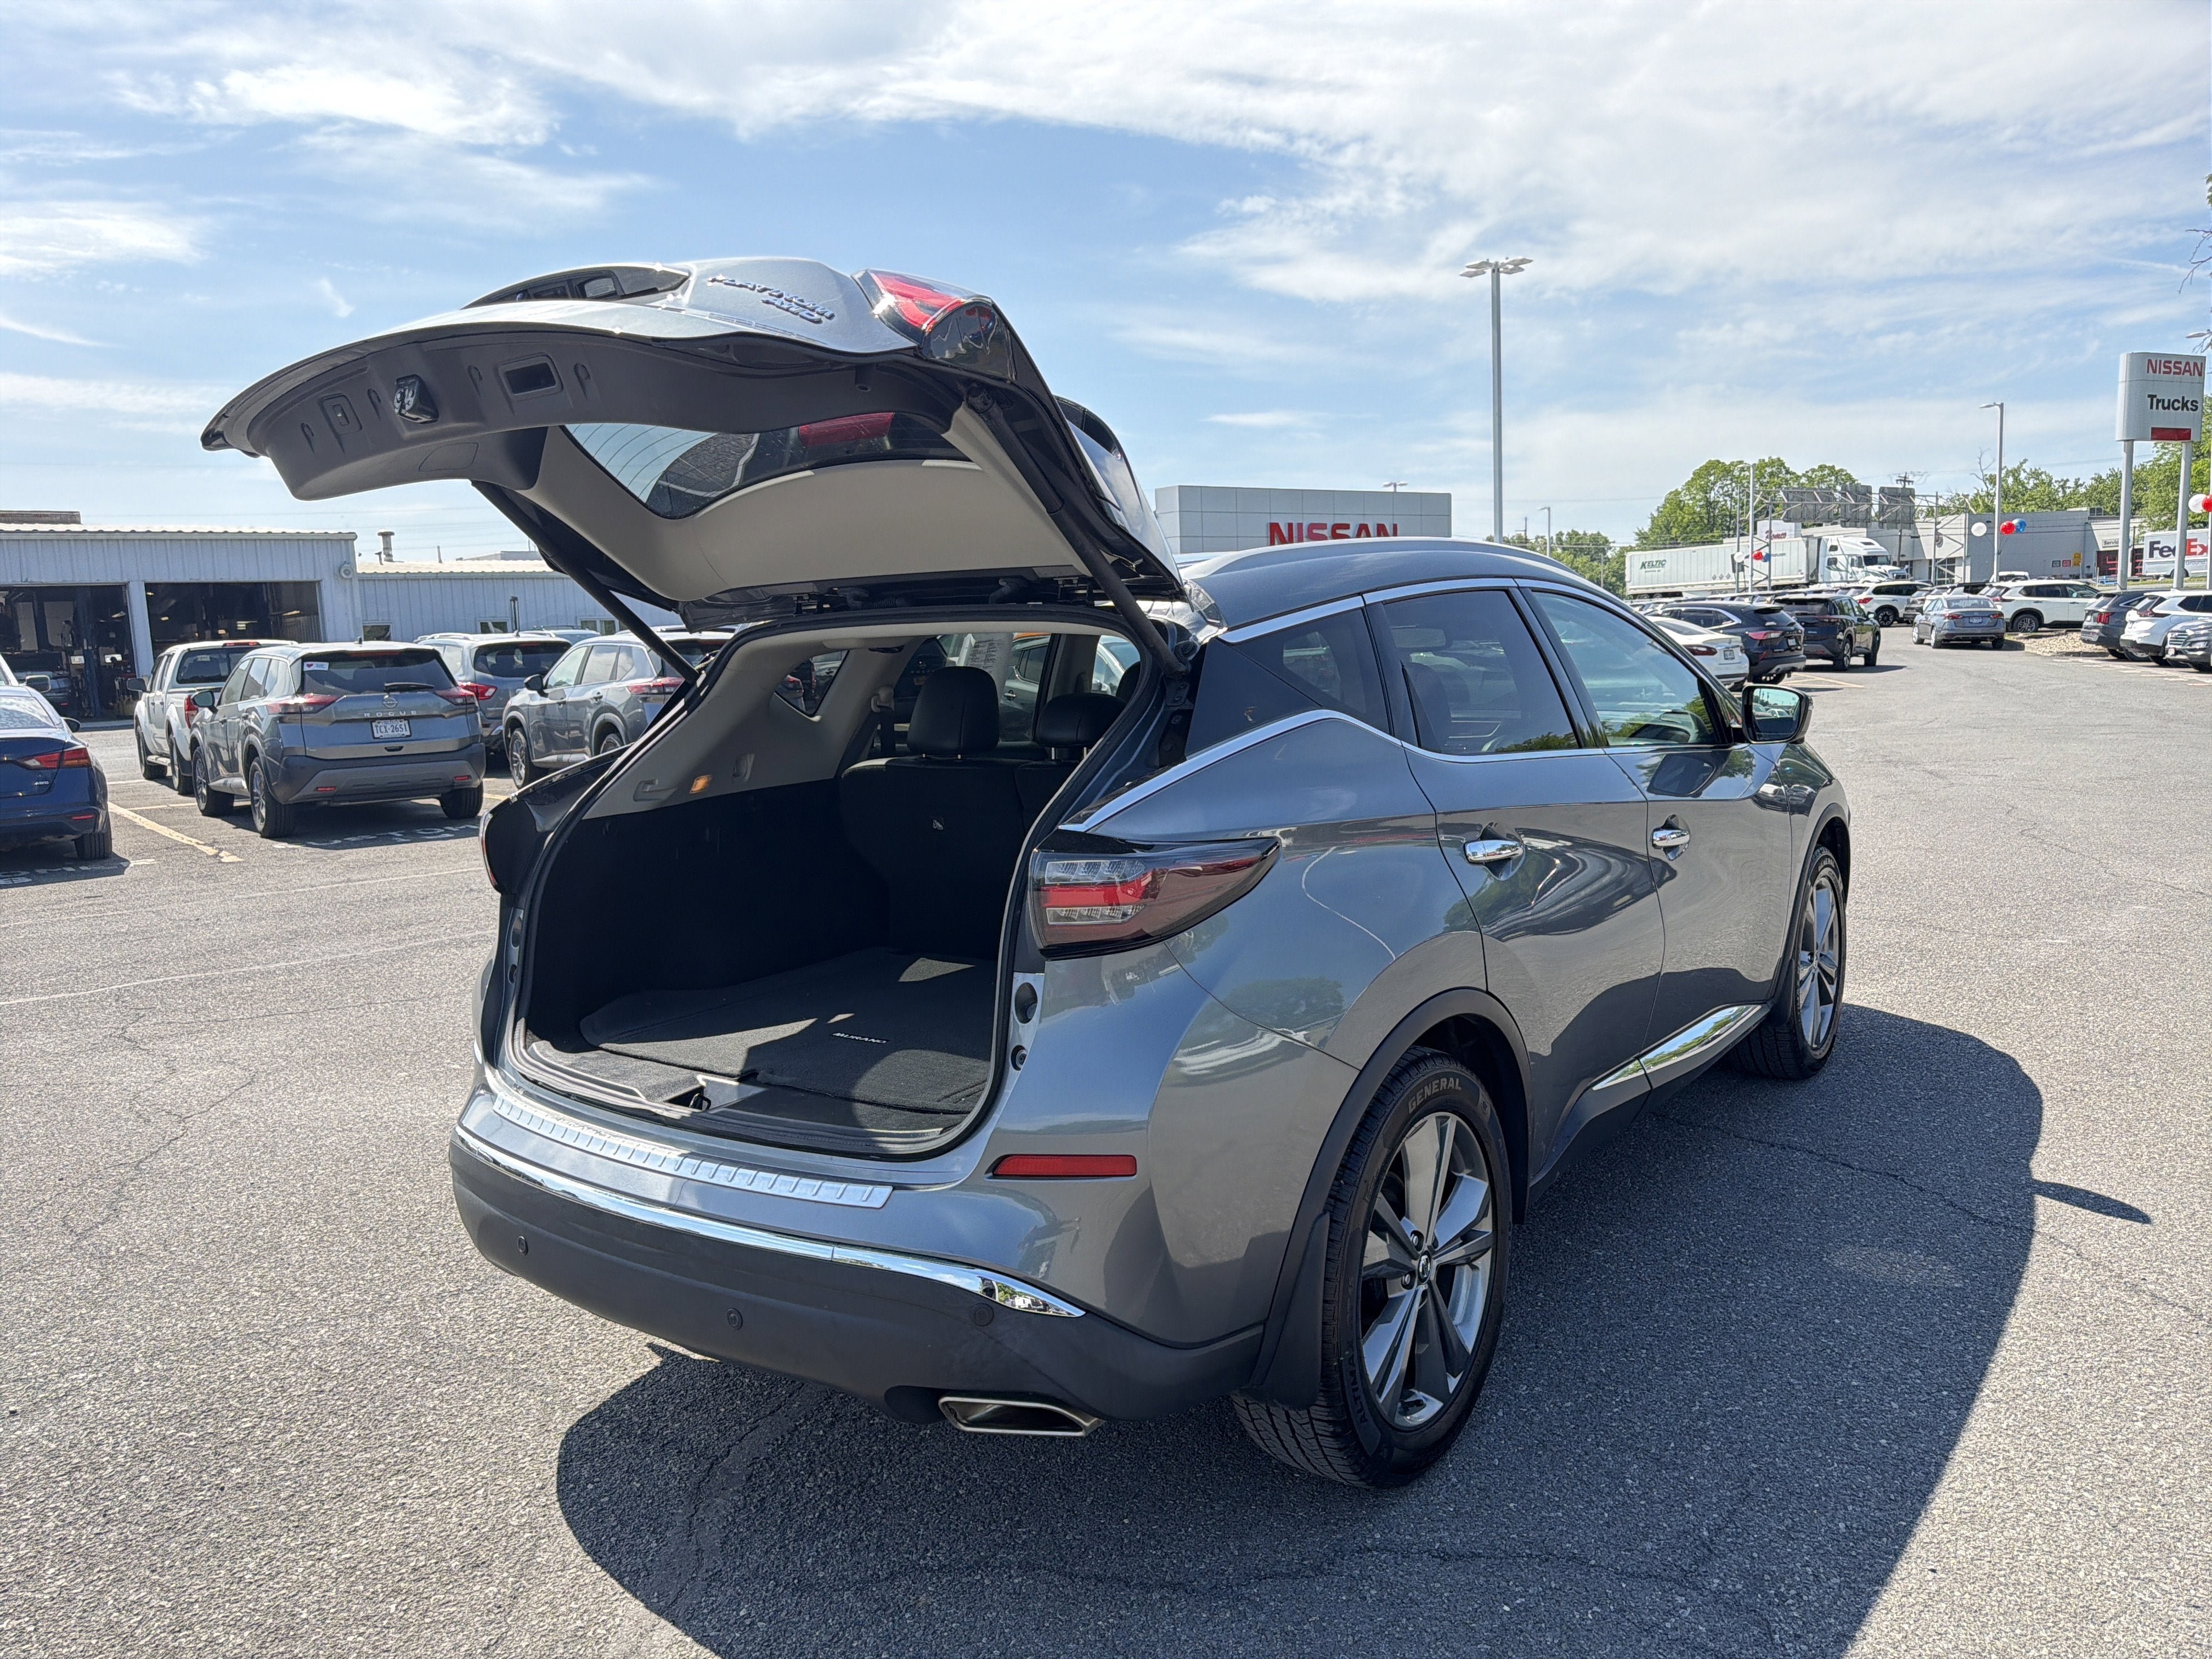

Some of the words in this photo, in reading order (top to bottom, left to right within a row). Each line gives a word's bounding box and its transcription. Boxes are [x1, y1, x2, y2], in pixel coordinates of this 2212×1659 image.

[761, 298, 823, 324] AWD
[2146, 359, 2203, 377] NISSAN
[2147, 394, 2199, 411] Trucks
[1269, 522, 1398, 546] NISSAN
[2148, 538, 2209, 558] FeEx
[1640, 559, 1667, 570] KELTIC
[375, 723, 408, 734] TCX-2651
[832, 1032, 888, 1043] MURANO
[1408, 1077, 1462, 1114] GENERAL
